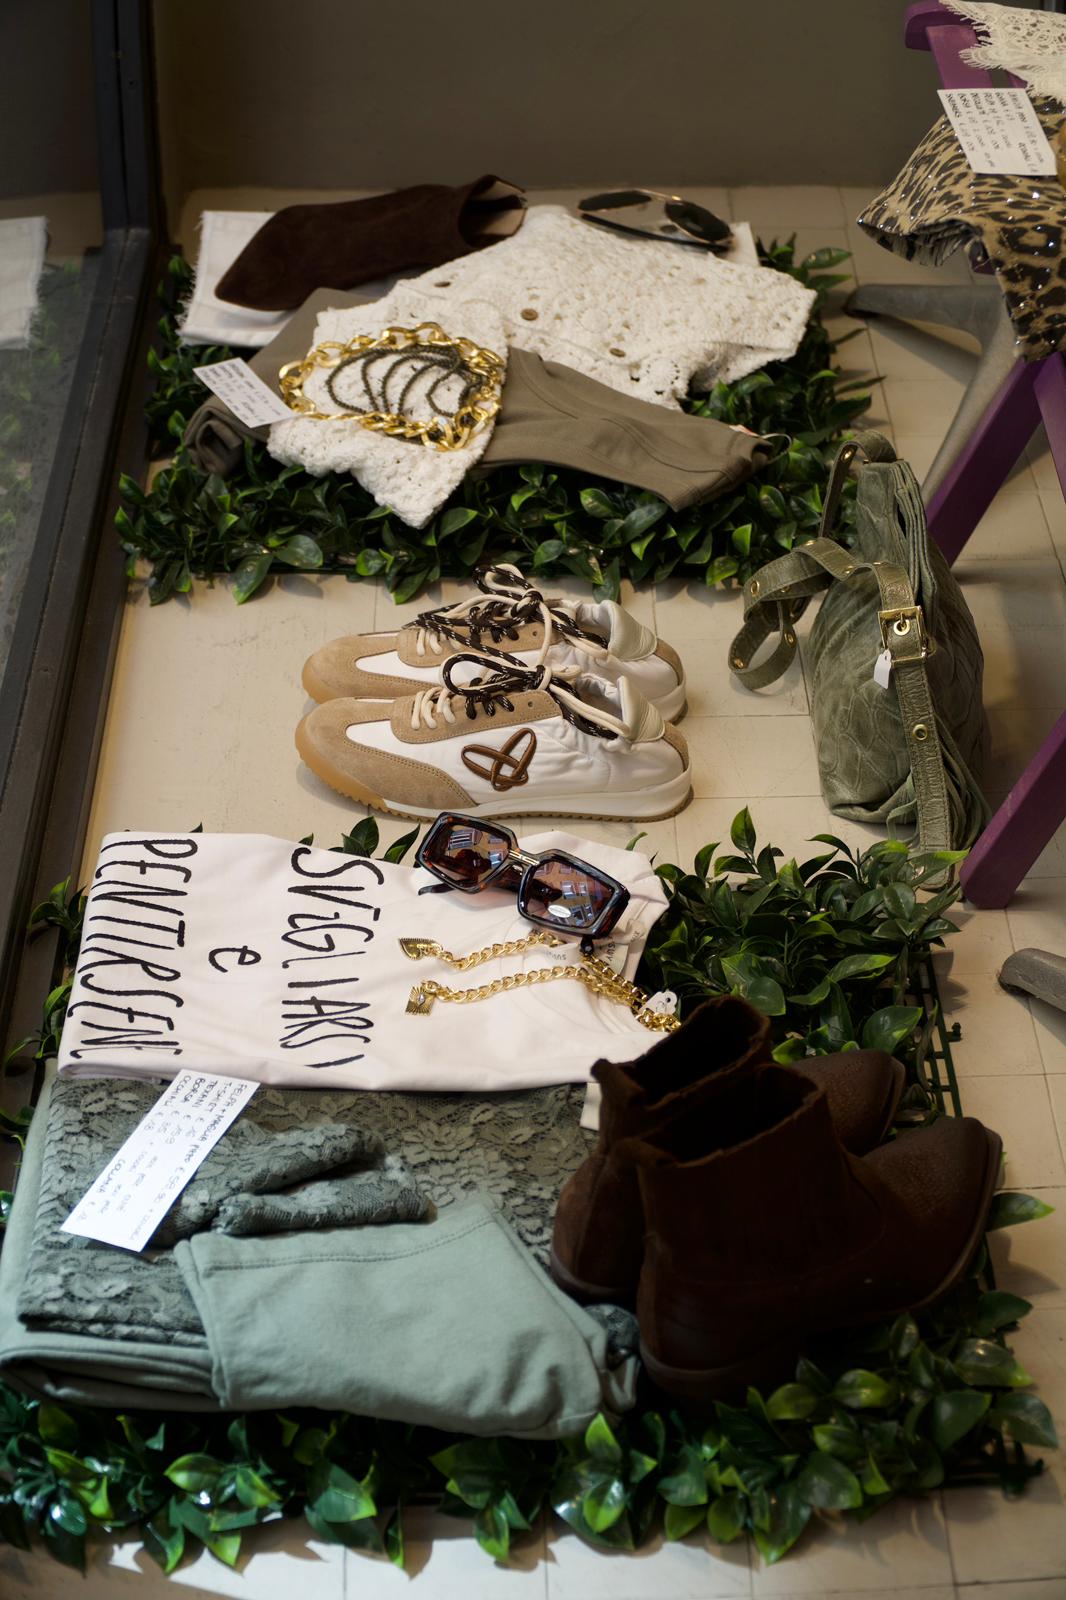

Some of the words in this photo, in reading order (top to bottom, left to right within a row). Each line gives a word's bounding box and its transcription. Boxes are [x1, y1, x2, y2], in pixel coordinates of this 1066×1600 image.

[67, 839, 198, 1058] PENTIRSENE
[179, 1076, 205, 1104] BORSA
[191, 1079, 218, 1108] TEXANI
[224, 1083, 248, 1107] FELPA
